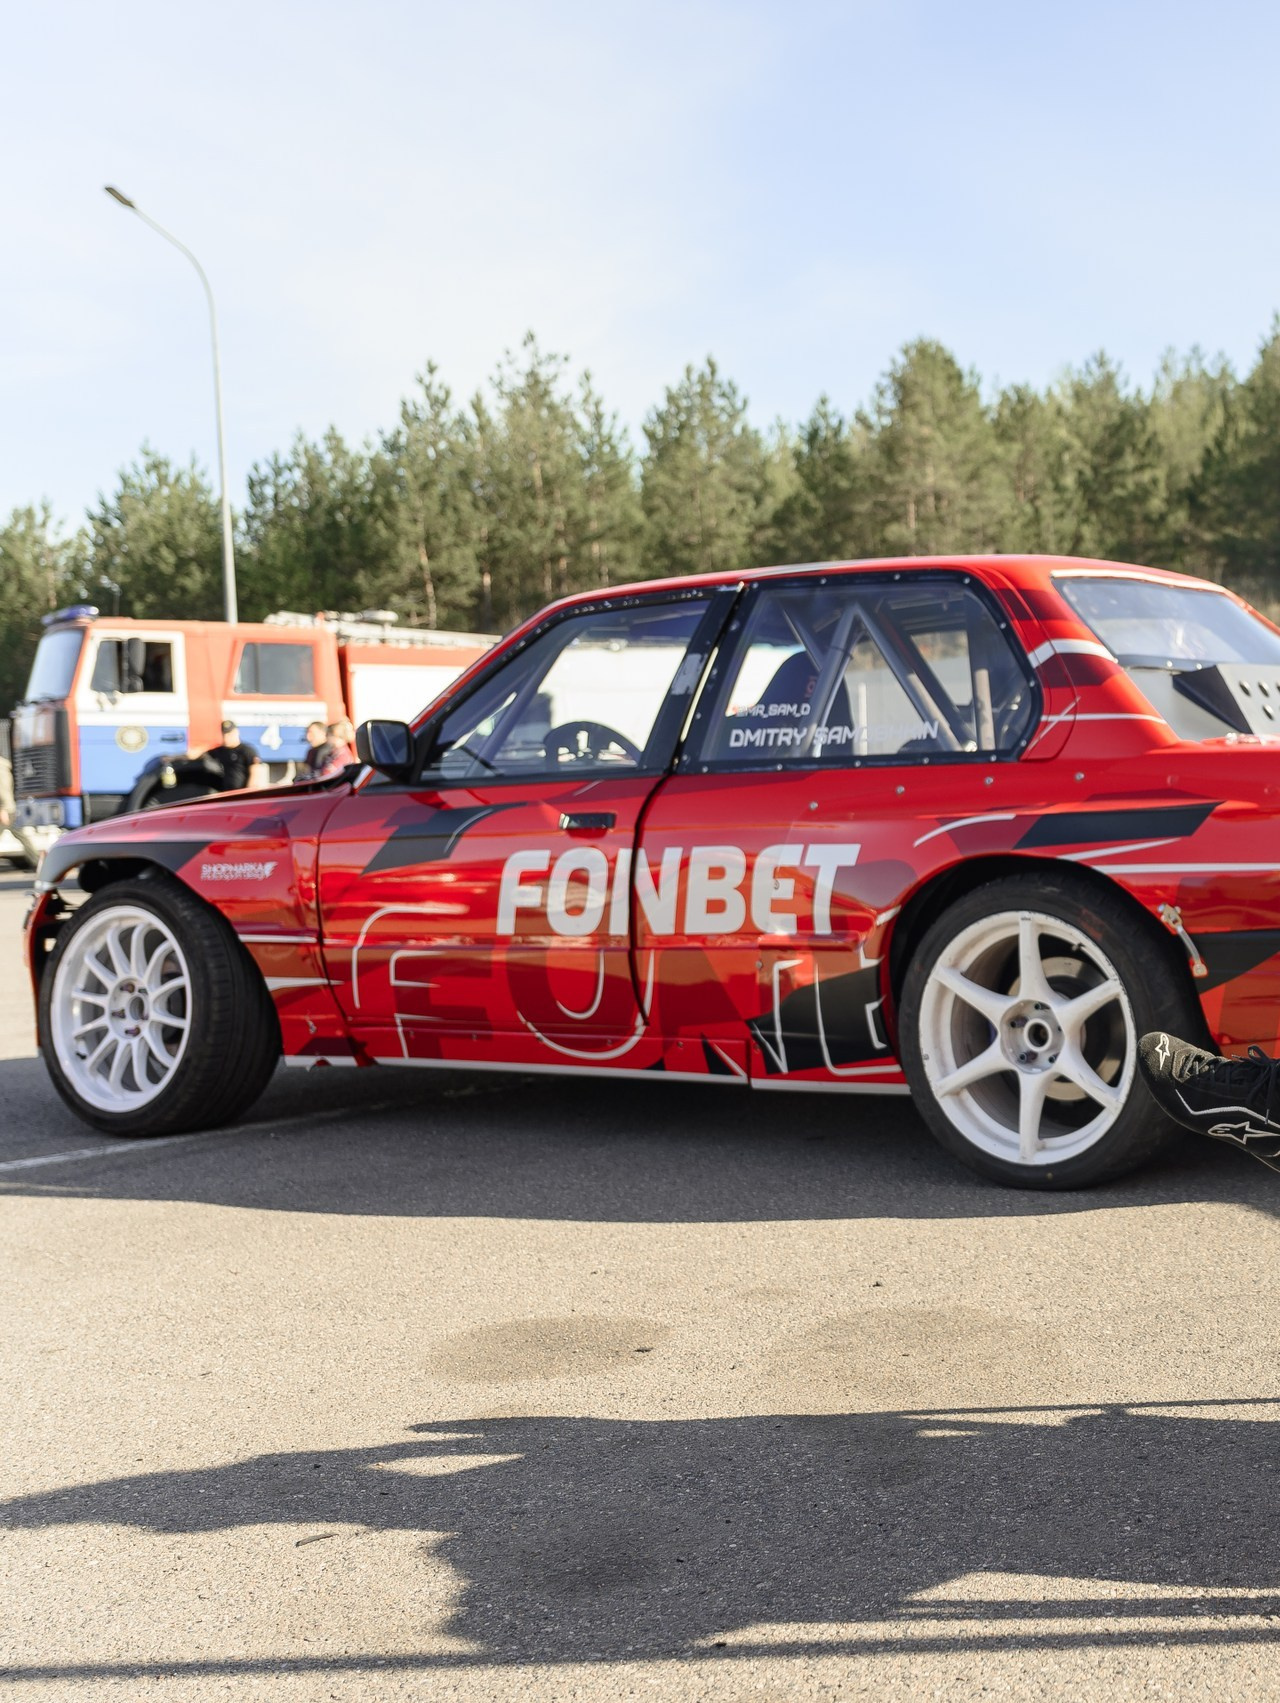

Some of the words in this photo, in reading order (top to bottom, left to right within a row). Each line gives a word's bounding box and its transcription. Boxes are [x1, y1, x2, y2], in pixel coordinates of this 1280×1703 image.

[260, 724, 283, 750] 4
[729, 726, 807, 748] DMITRY
[496, 843, 862, 937] FONBET
